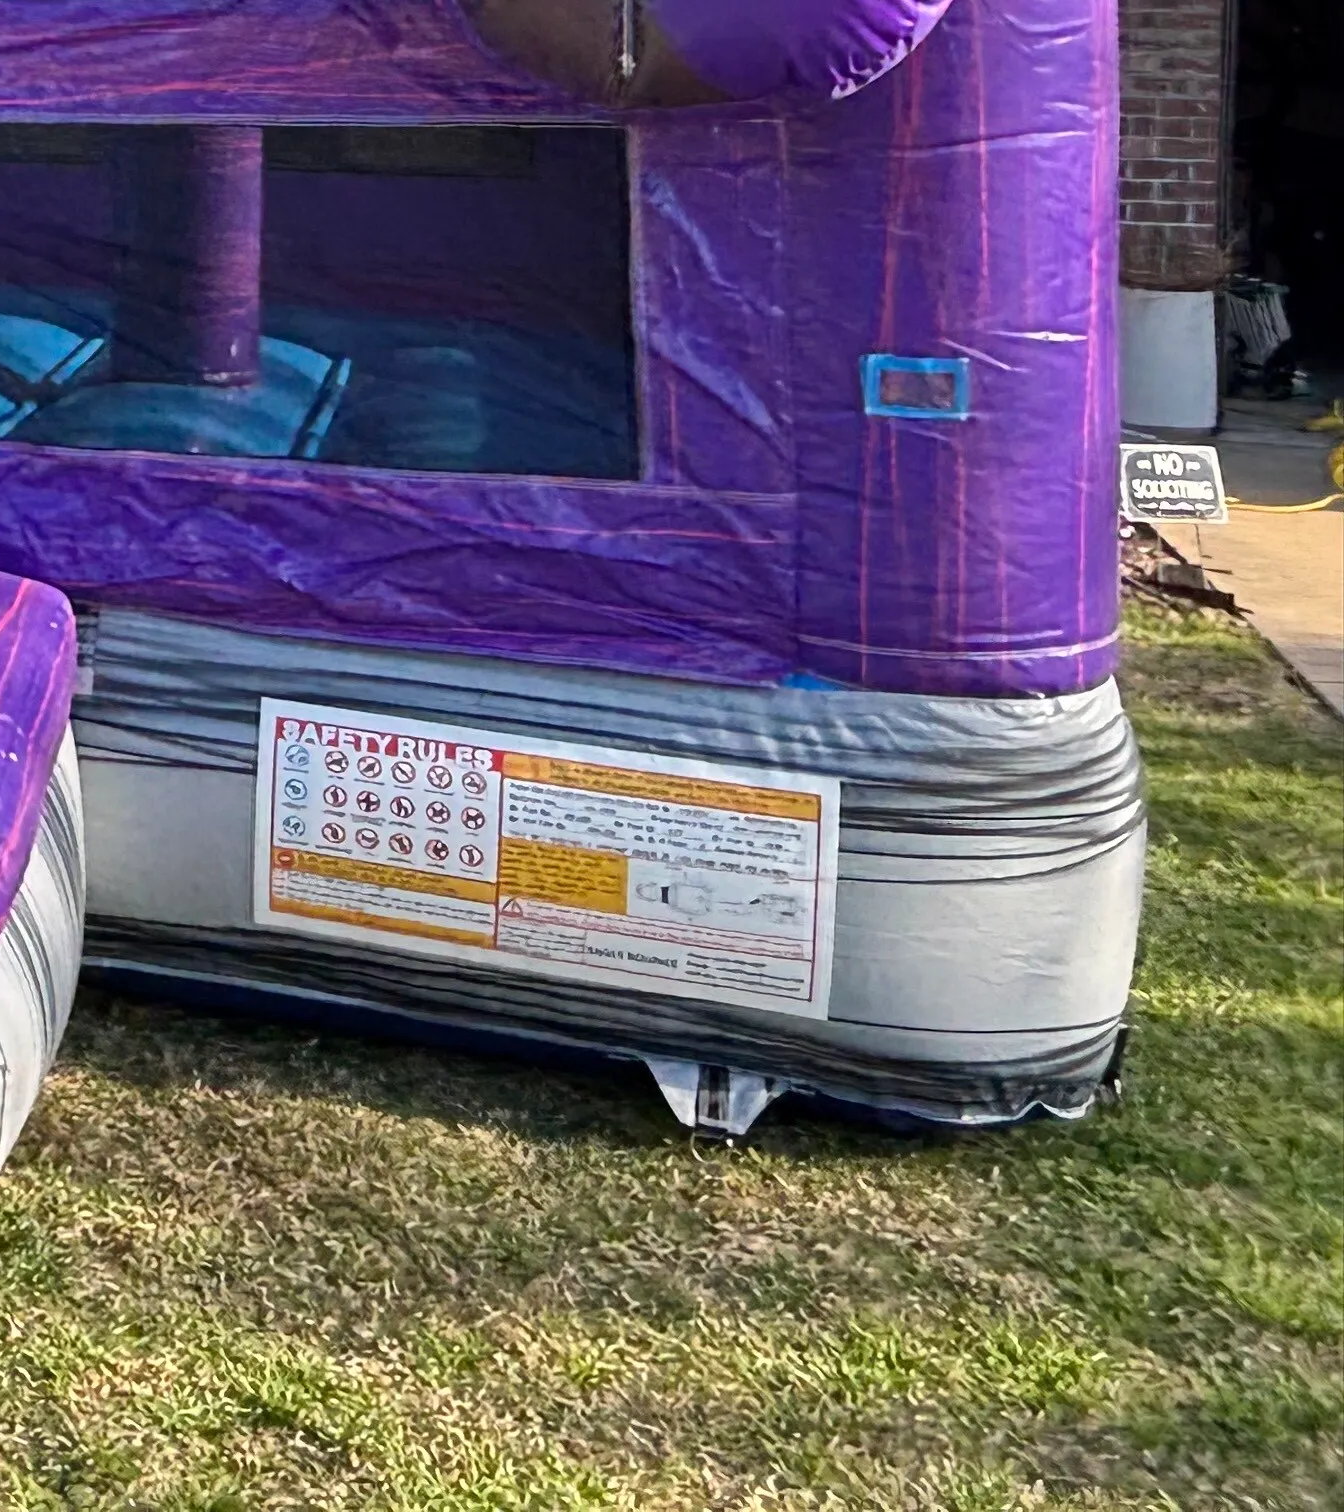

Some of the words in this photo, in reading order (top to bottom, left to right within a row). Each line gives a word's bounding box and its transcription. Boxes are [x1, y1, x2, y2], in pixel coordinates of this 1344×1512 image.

[1152, 452, 1184, 476] NO
[281, 719, 392, 756] SAFETY
[396, 736, 494, 771] RULES
